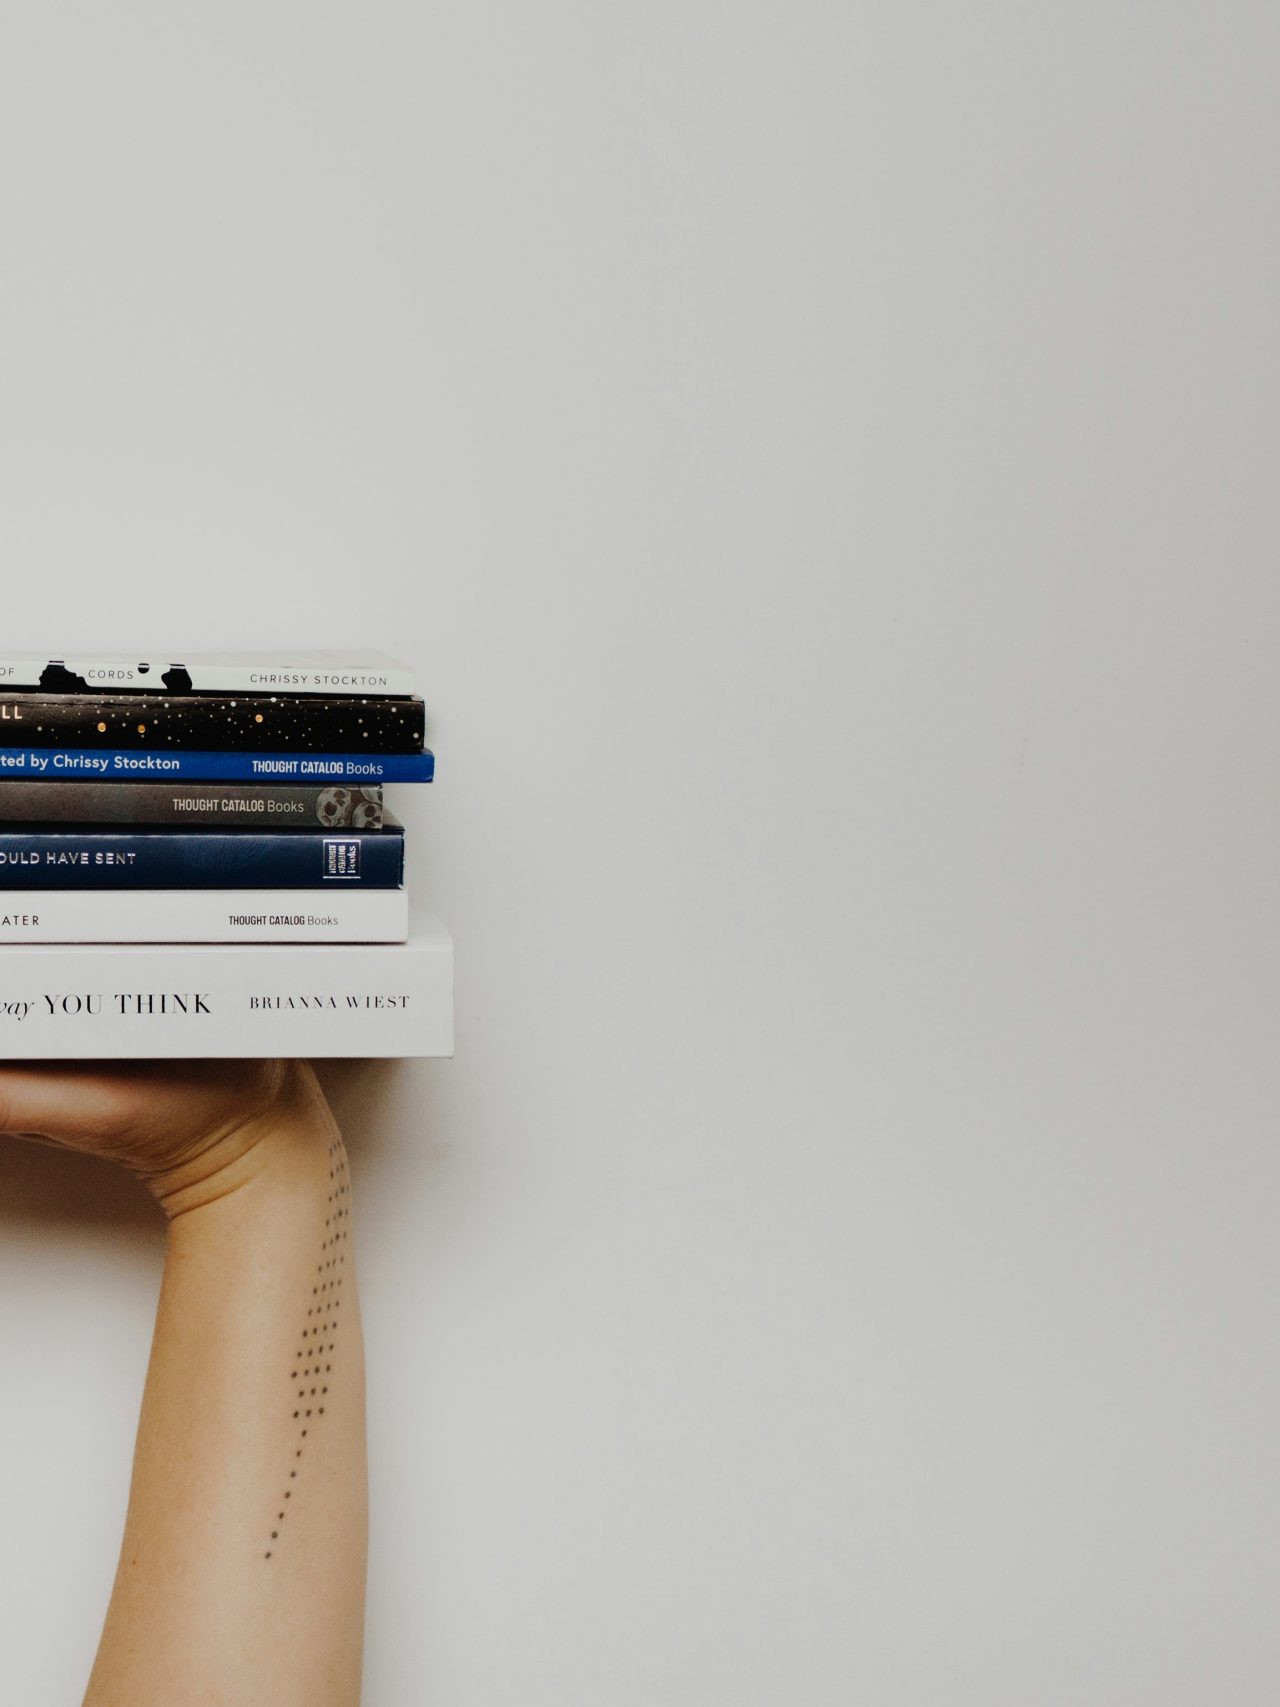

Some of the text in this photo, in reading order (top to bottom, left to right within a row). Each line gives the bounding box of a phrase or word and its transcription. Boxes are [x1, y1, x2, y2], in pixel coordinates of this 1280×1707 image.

[87, 669, 134, 681] CORDS
[249, 673, 387, 686] CHRISSY STOCKTON
[30, 753, 49, 771] by
[53, 754, 109, 772] Chrissy
[113, 755, 180, 770] Stockton
[252, 760, 384, 775] THOUGHT CATALOG Books
[172, 798, 305, 813] THOUGHT CATALOG Books
[46, 852, 90, 865] HAVE
[95, 852, 136, 865] SENT
[228, 915, 339, 926] THOUGHT CATALOG Books
[44, 994, 104, 1015] YOU
[114, 993, 211, 1014] THINK
[250, 996, 410, 1009] BRIANNA WIEST
